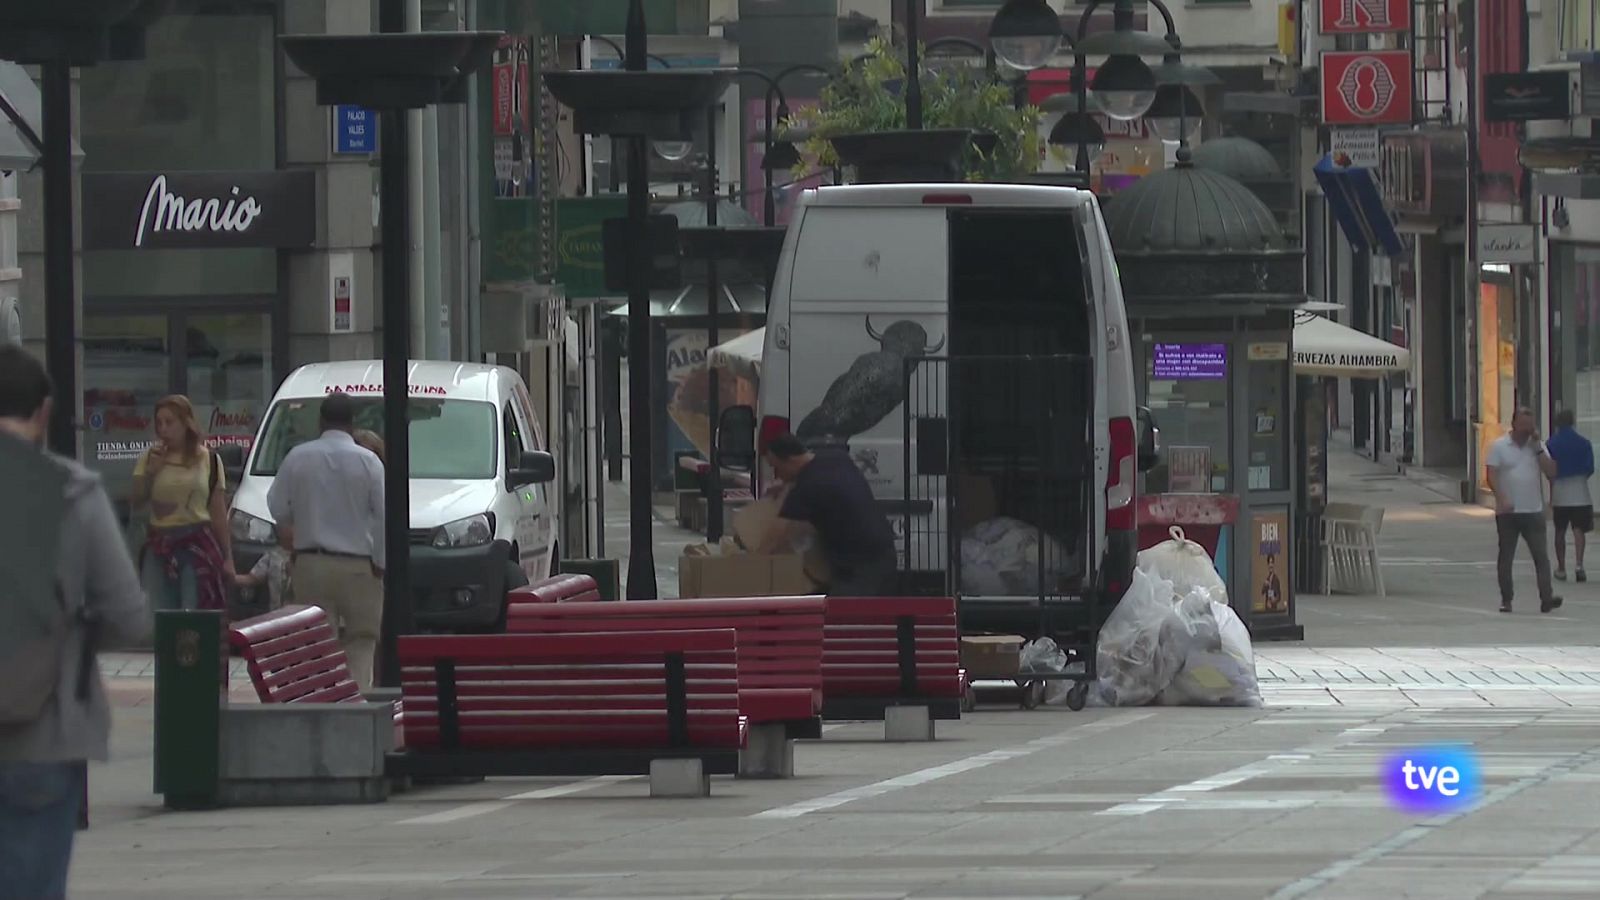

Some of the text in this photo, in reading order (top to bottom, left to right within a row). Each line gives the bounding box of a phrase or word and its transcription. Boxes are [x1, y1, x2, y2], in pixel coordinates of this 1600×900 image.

[135, 174, 261, 247] Mario
[1293, 352, 1397, 367] ERVEZAS ALHAMBRA
[96, 442, 126, 451] TIENDA
[1261, 522, 1278, 541] BIEN
